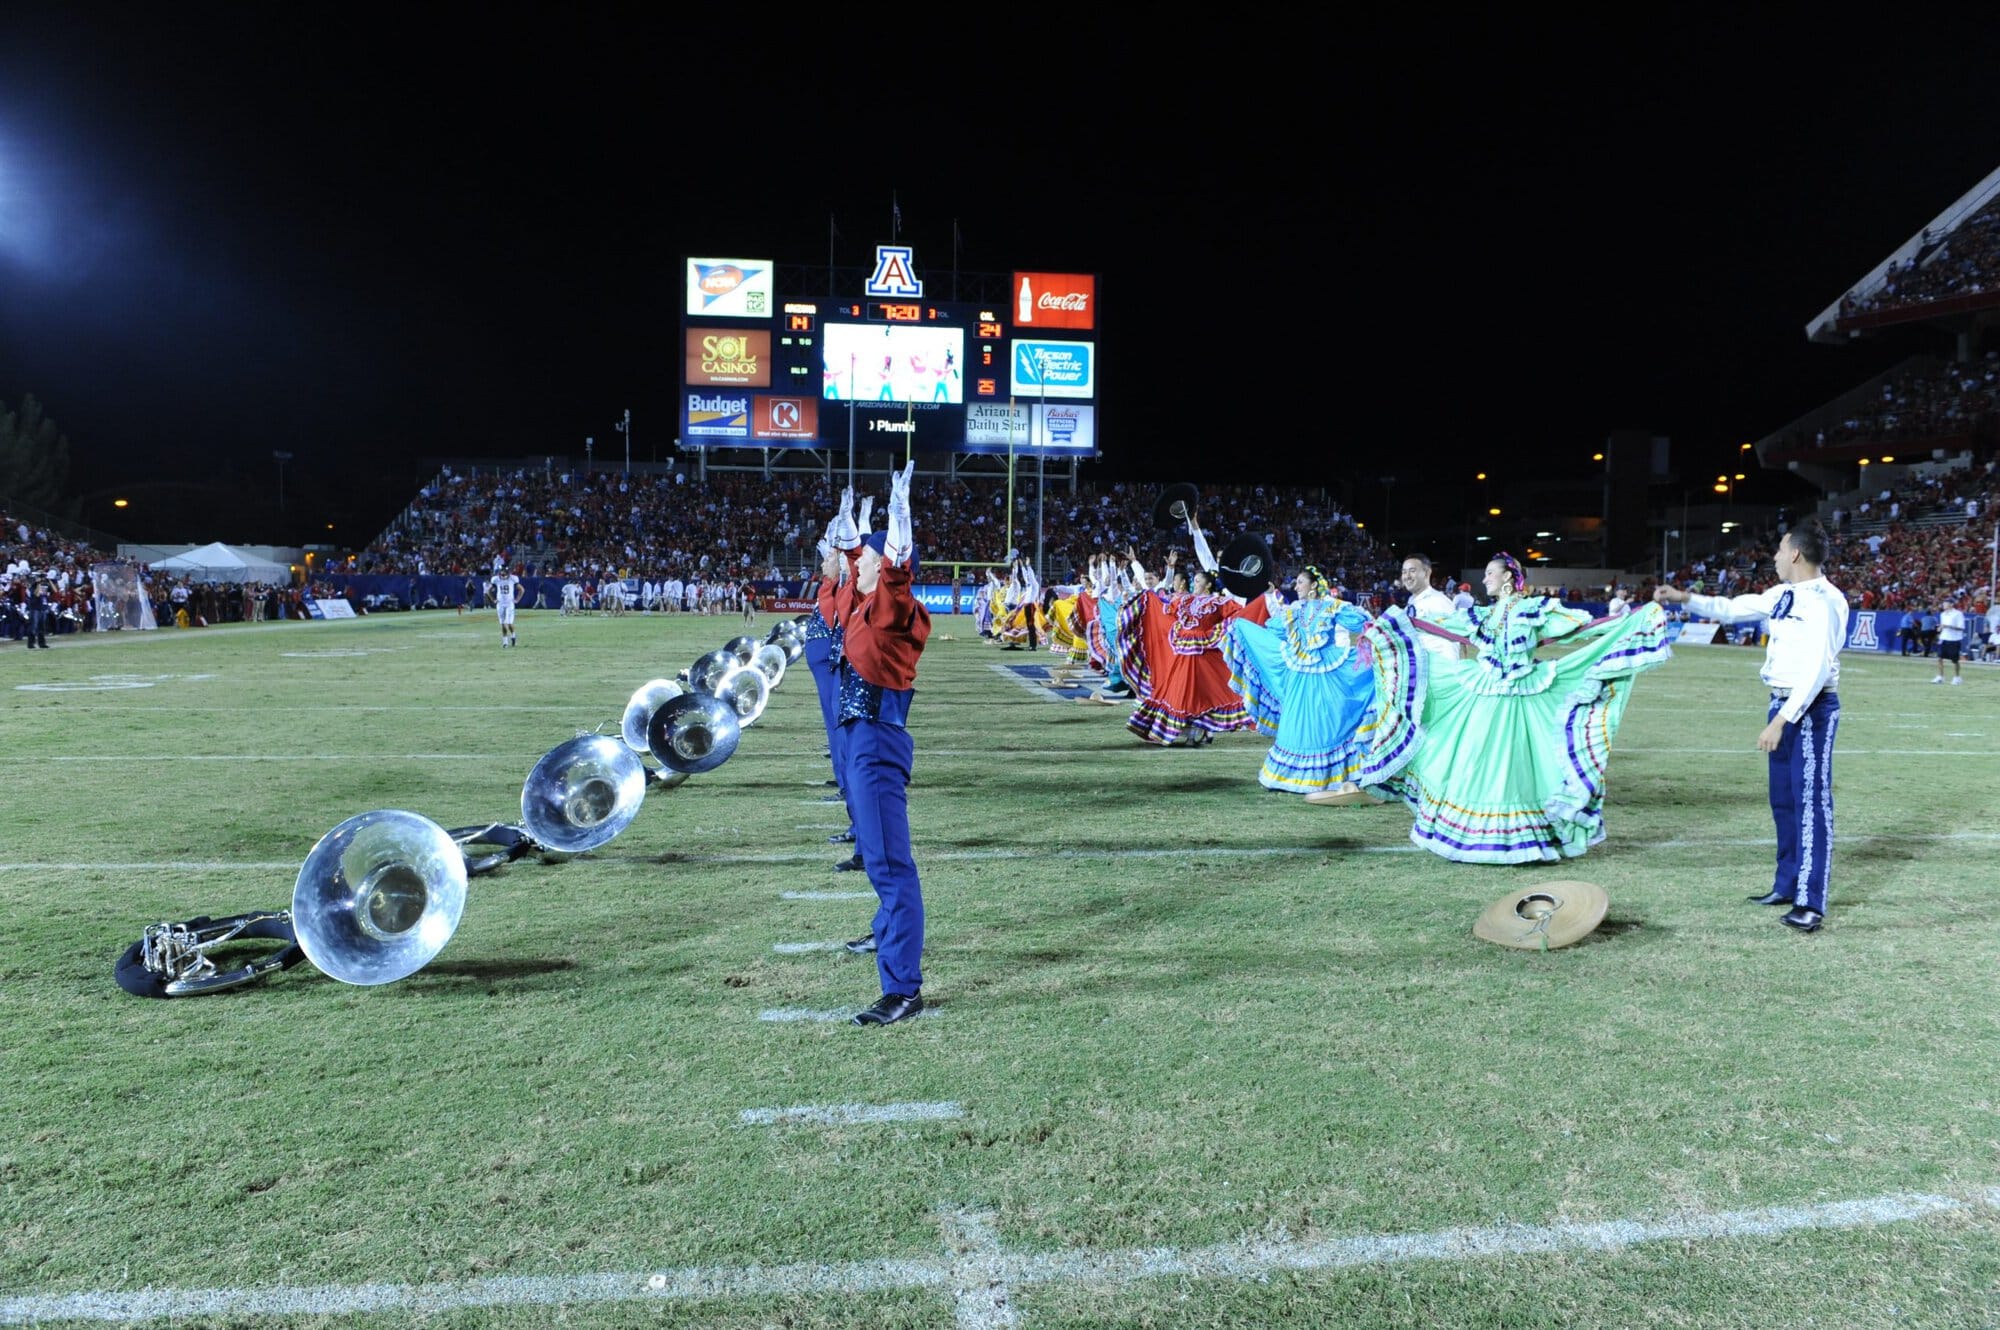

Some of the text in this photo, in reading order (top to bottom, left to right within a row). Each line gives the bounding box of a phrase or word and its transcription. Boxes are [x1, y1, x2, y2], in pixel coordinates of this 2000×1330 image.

[865, 245, 923, 298] A
[852, 305, 860, 316] 3
[880, 304, 920, 320] 7:20
[928, 308, 936, 319] 3
[979, 323, 1001, 337] 24
[702, 335, 757, 362] SOL
[1034, 348, 1072, 360] Tucson
[983, 353, 991, 365] 3
[1038, 359, 1082, 371] Electric
[702, 362, 757, 374] CASINOS
[1043, 370, 1082, 381] Power
[978, 379, 995, 395] 25
[688, 394, 747, 417] Budget
[967, 419, 1027, 432] Daily Sar
[774, 601, 787, 609] Go
[1849, 611, 1879, 650] A
